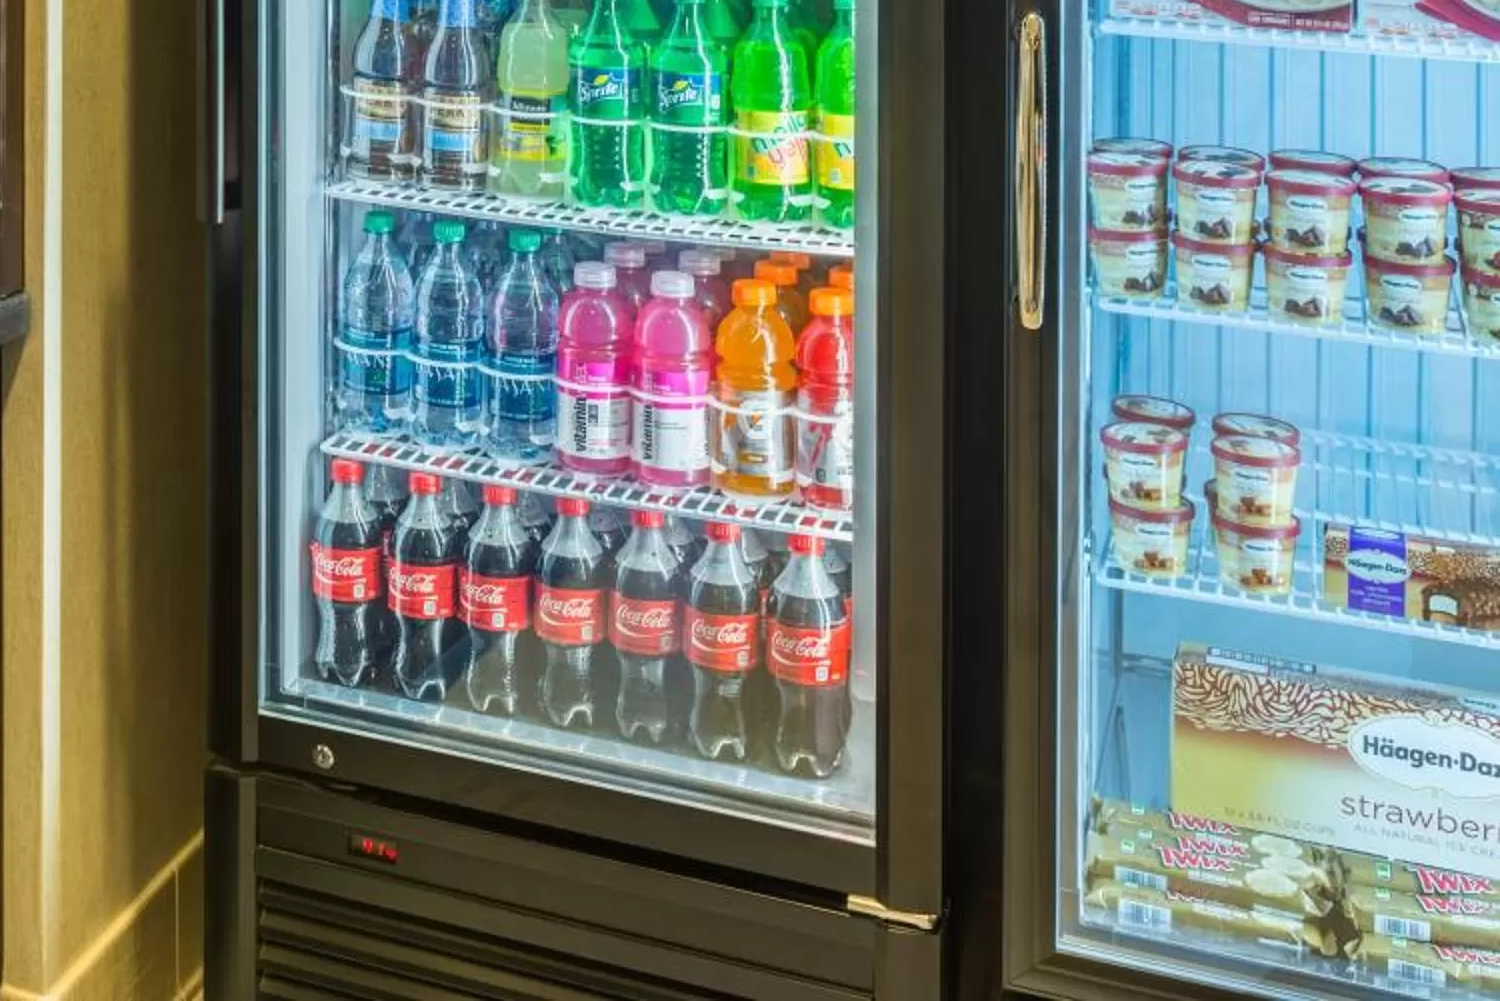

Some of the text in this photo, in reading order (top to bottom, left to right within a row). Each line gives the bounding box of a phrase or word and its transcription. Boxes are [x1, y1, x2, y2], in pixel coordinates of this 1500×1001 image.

[539, 594, 596, 618] Coca-Cola
[616, 604, 673, 629] Coca-Cola
[690, 618, 749, 644] Coca-Cola
[771, 630, 831, 658] Coca-Cola
[1340, 794, 1500, 842] strawber
